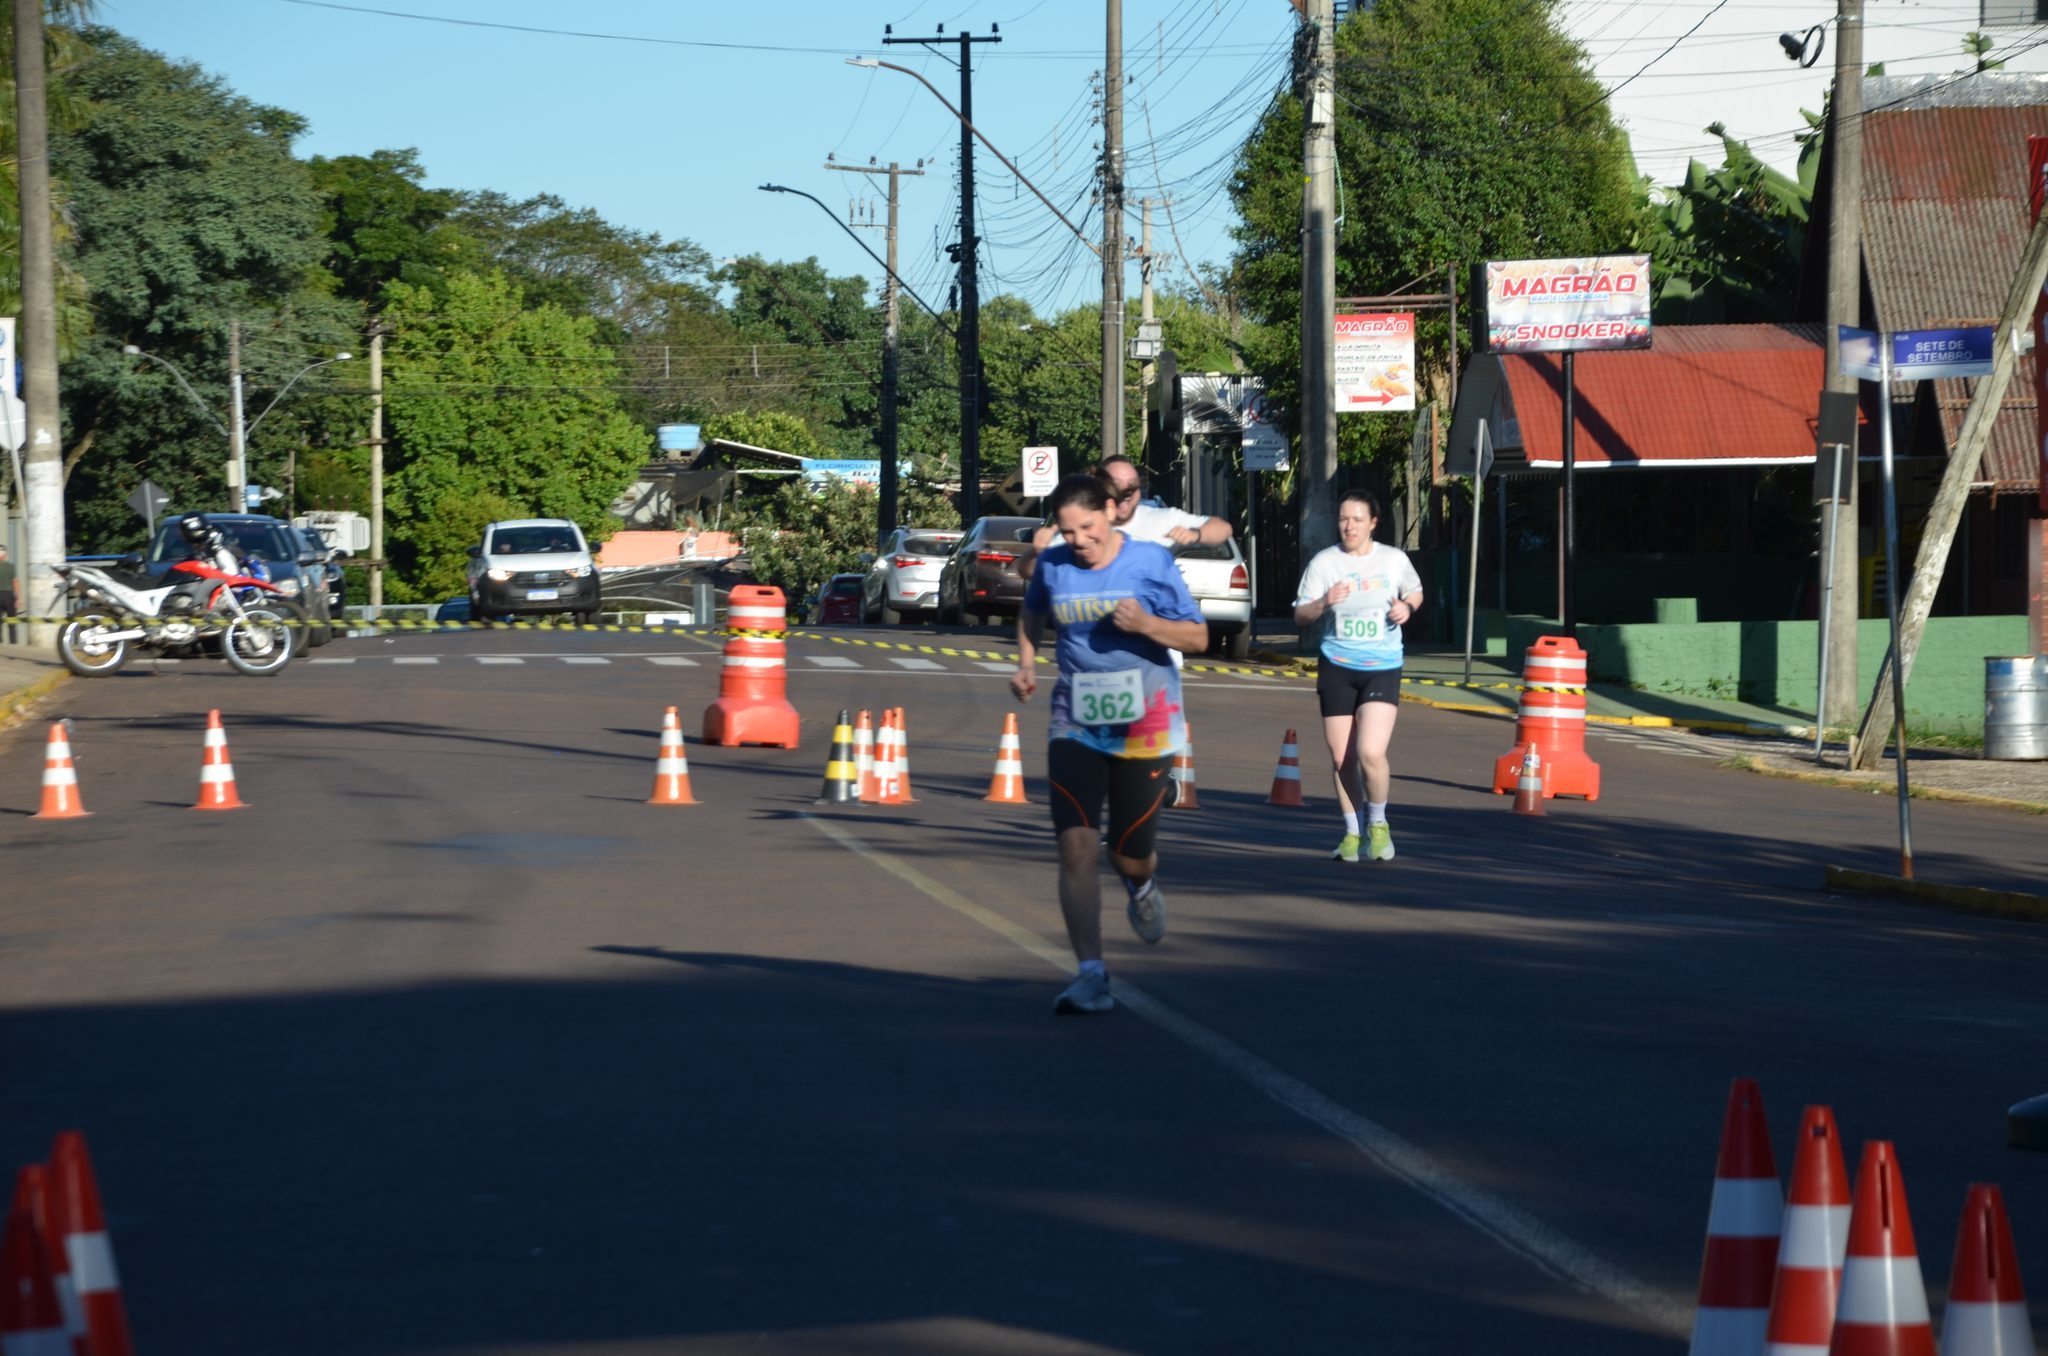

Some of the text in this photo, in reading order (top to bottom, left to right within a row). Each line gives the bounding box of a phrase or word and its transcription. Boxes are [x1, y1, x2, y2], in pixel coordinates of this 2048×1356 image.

[1502, 268, 1638, 297] MAGRÃO
[1335, 317, 1408, 333] MAGRÃO
[1517, 323, 1625, 340] SNOOKER
[1915, 340, 1965, 352] SETE DE
[1907, 351, 1973, 363] SETEMBRO
[1343, 620, 1378, 637] 509
[1082, 691, 1136, 721] 362
